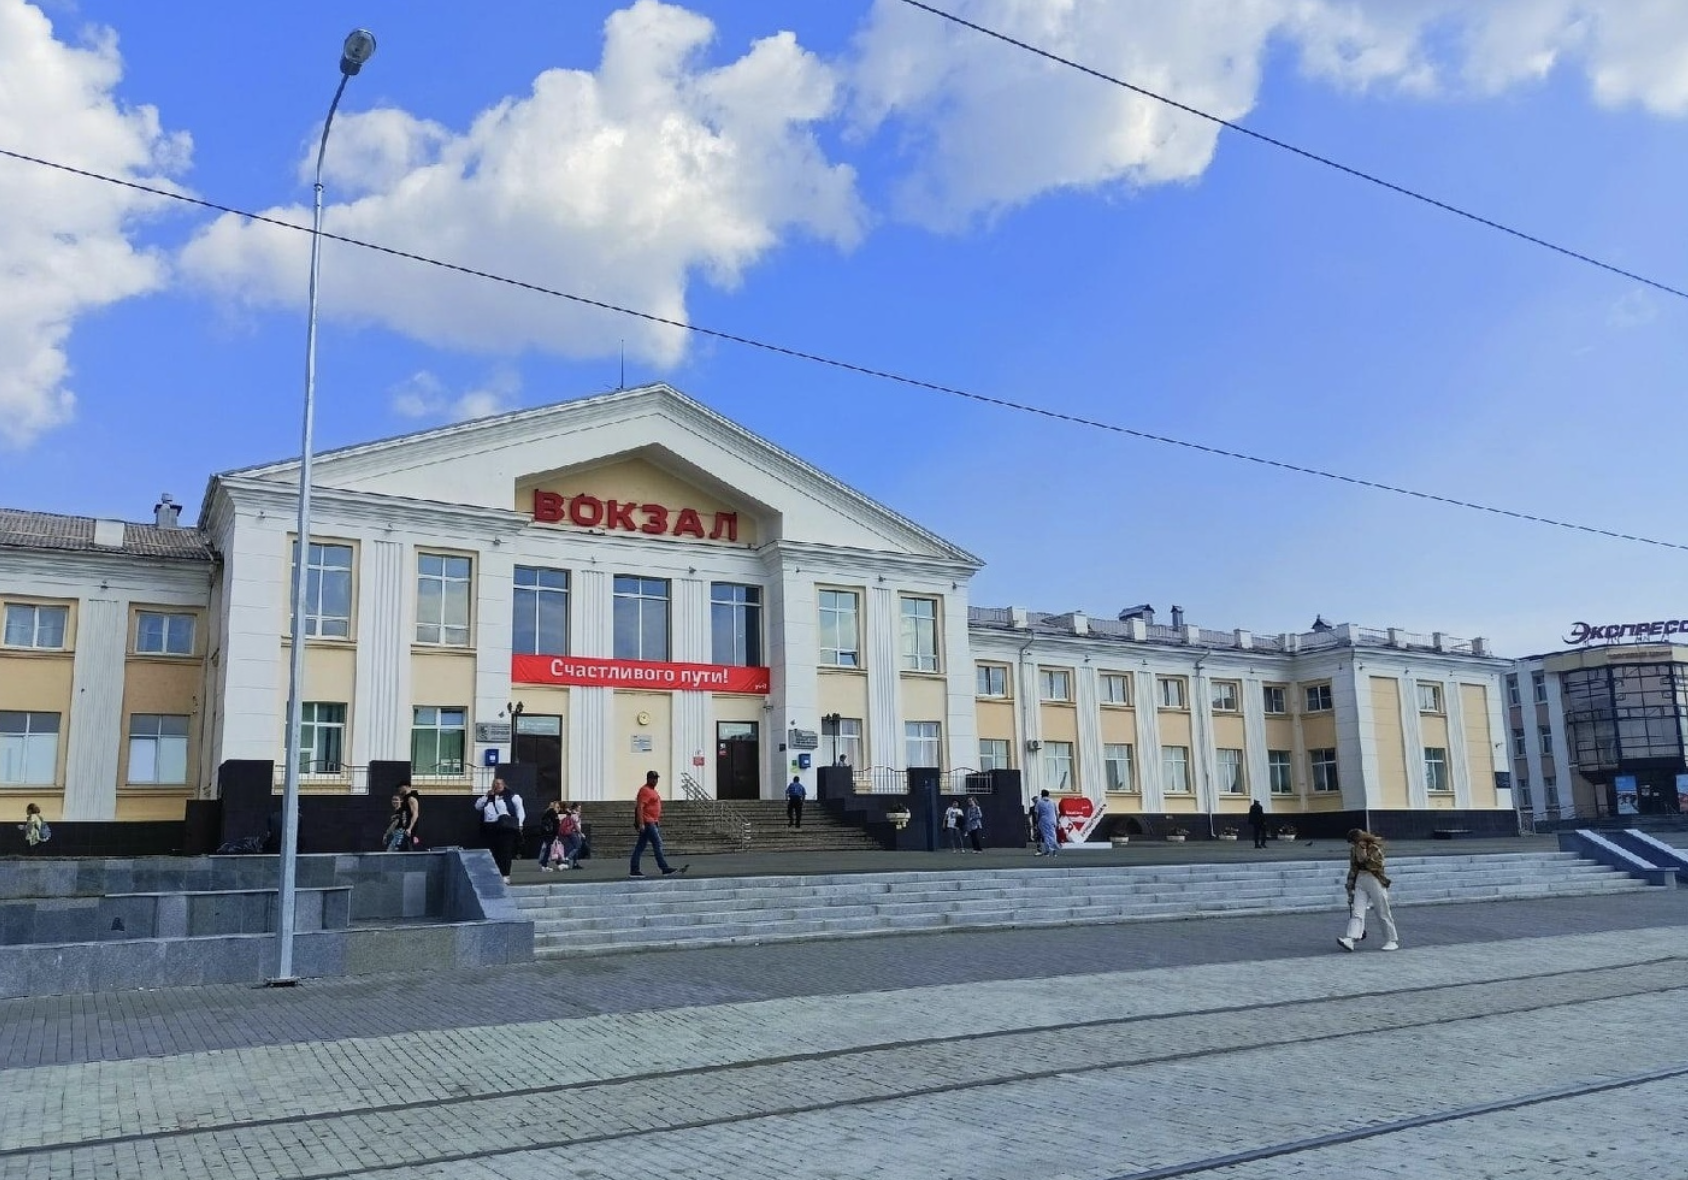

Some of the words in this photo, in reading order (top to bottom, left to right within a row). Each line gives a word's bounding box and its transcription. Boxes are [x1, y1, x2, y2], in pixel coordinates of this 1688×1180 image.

[534, 490, 737, 541] ВОКЗАЛ
[551, 659, 675, 682] Счастливого
[680, 669, 729, 687] пути!
